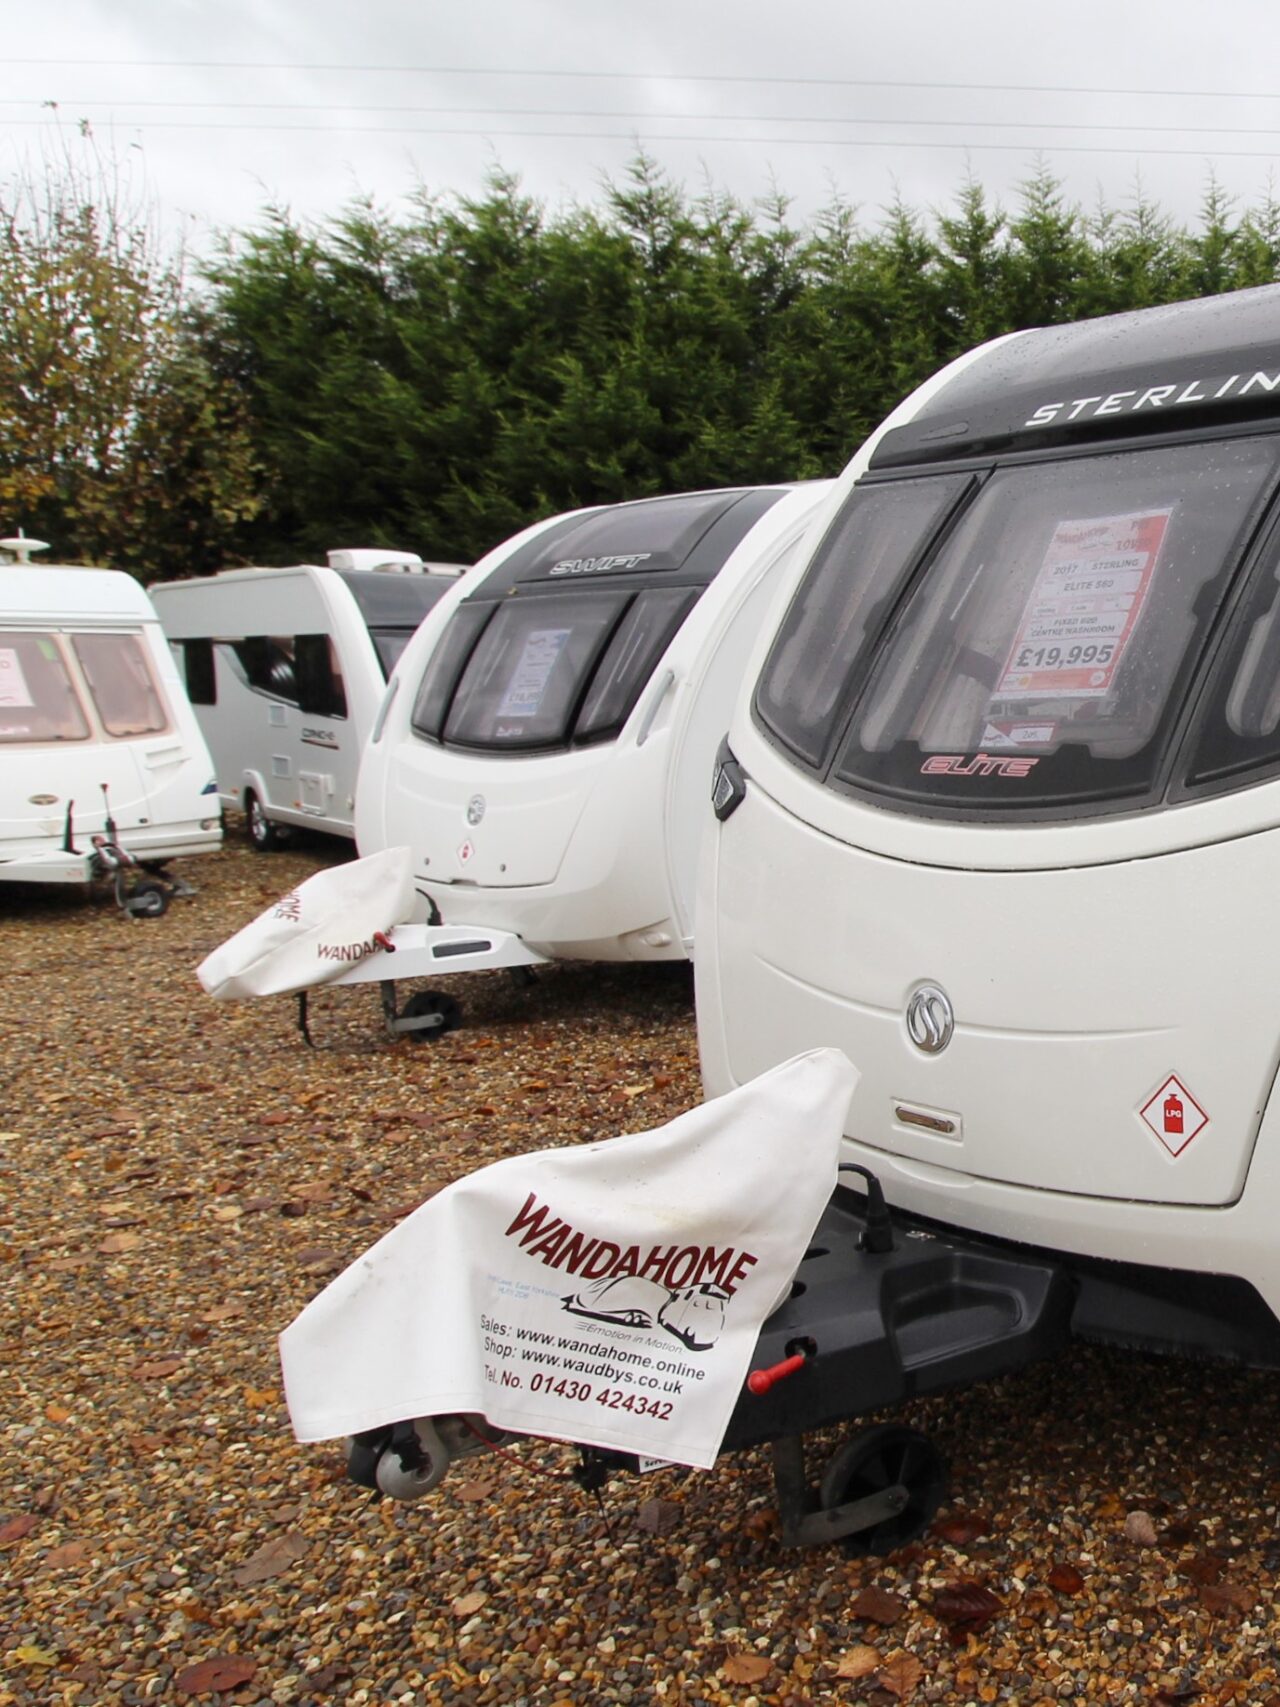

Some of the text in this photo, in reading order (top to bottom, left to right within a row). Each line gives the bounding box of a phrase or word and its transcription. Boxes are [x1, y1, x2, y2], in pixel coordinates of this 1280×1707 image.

[549, 553, 651, 575] SWIFT
[1053, 558, 1139, 575] 2017 STERLING
[1063, 580, 1093, 592] ELITE
[1016, 644, 1115, 670] £19,995
[920, 753, 1040, 777] ELITE
[1165, 1109, 1182, 1118] LPG
[505, 1192, 758, 1296] WANDAHOME
[586, 1323, 633, 1342] Emotion
[635, 1334, 644, 1344] in
[480, 1314, 706, 1381] Sales: www.wandahome.online
[484, 1336, 684, 1395] Shop: www.waudbys.co.uk
[484, 1364, 674, 1421] Tel. No. 01430 424342
